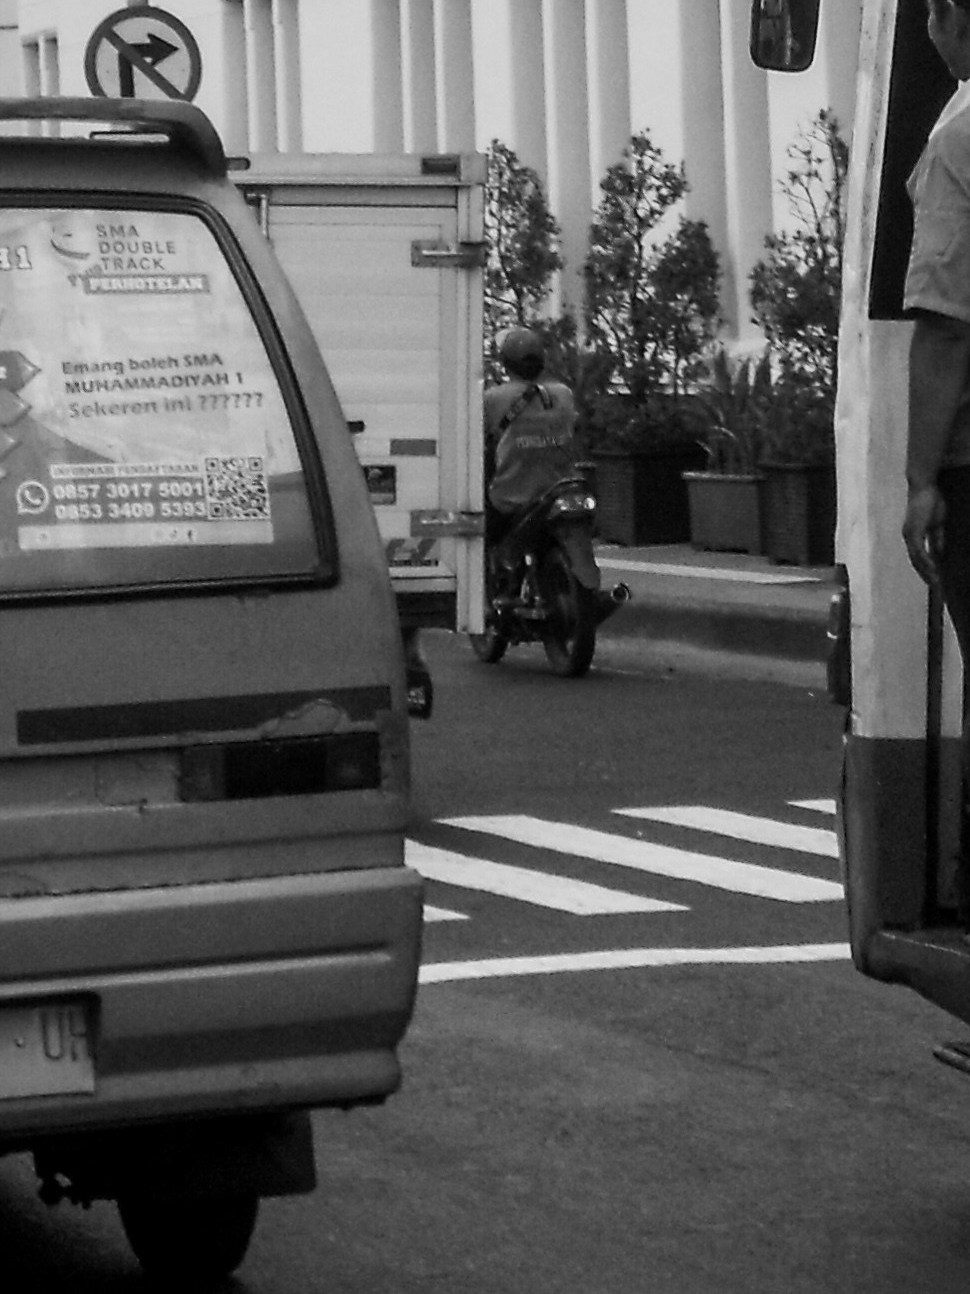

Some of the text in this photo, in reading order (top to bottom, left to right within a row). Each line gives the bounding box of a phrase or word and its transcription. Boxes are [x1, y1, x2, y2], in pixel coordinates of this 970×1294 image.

[96, 224, 139, 239] SMA
[99, 241, 177, 255] DOUBLE
[102, 257, 166, 271] TRACK
[62, 353, 224, 375] Emang boleh SMA
[65, 372, 230, 395] MUHAMMADIYAH
[106, 482, 153, 499] 3017
[158, 481, 205, 498] 5001
